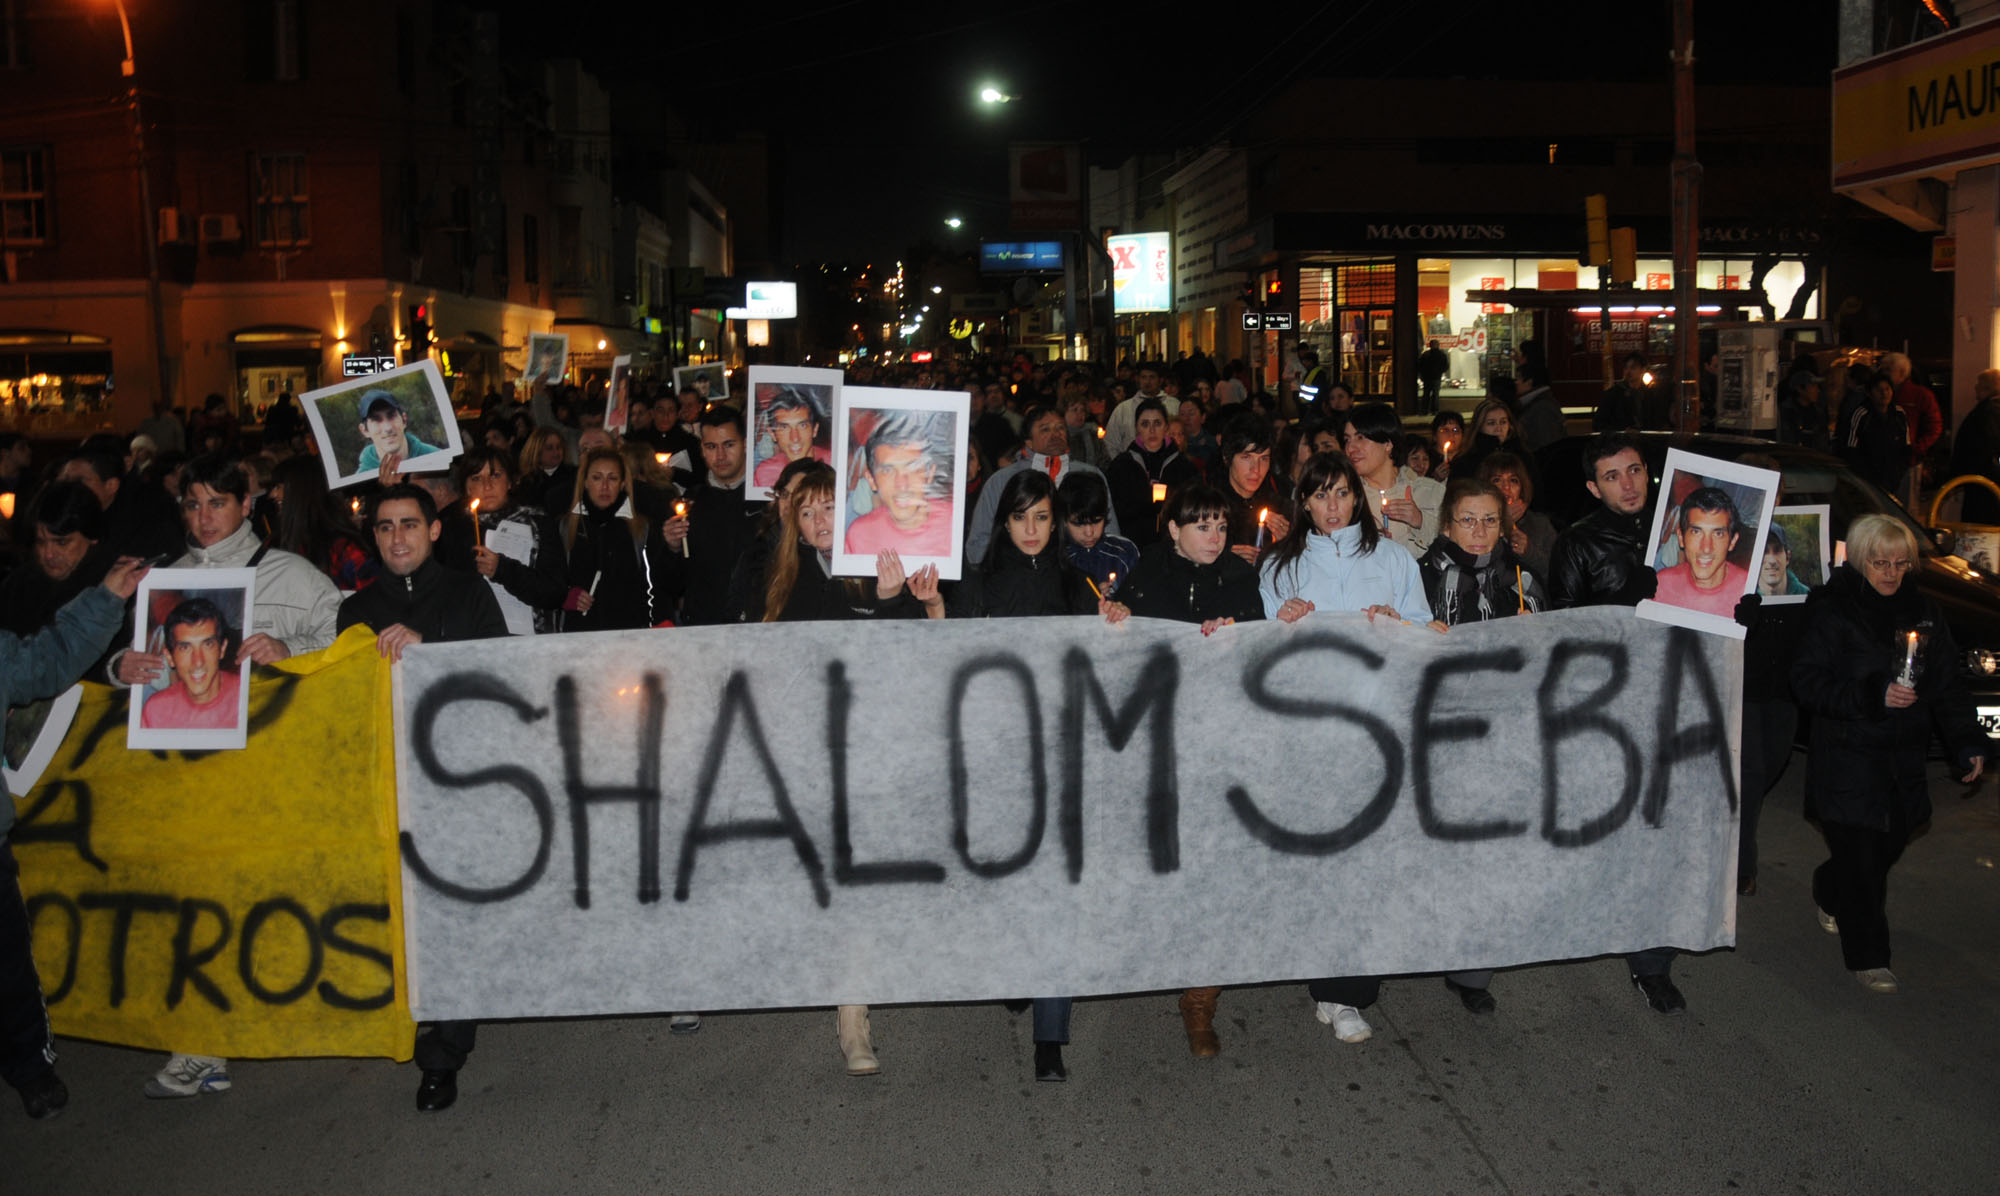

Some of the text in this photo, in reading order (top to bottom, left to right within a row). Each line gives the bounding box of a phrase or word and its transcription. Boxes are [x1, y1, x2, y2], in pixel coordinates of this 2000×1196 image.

[1366, 223, 1505, 241] MACOWENS
[1590, 322, 1643, 334] ESPARATE
[399, 644, 1179, 911] SHALOM
[1226, 627, 1740, 857] SEBA
